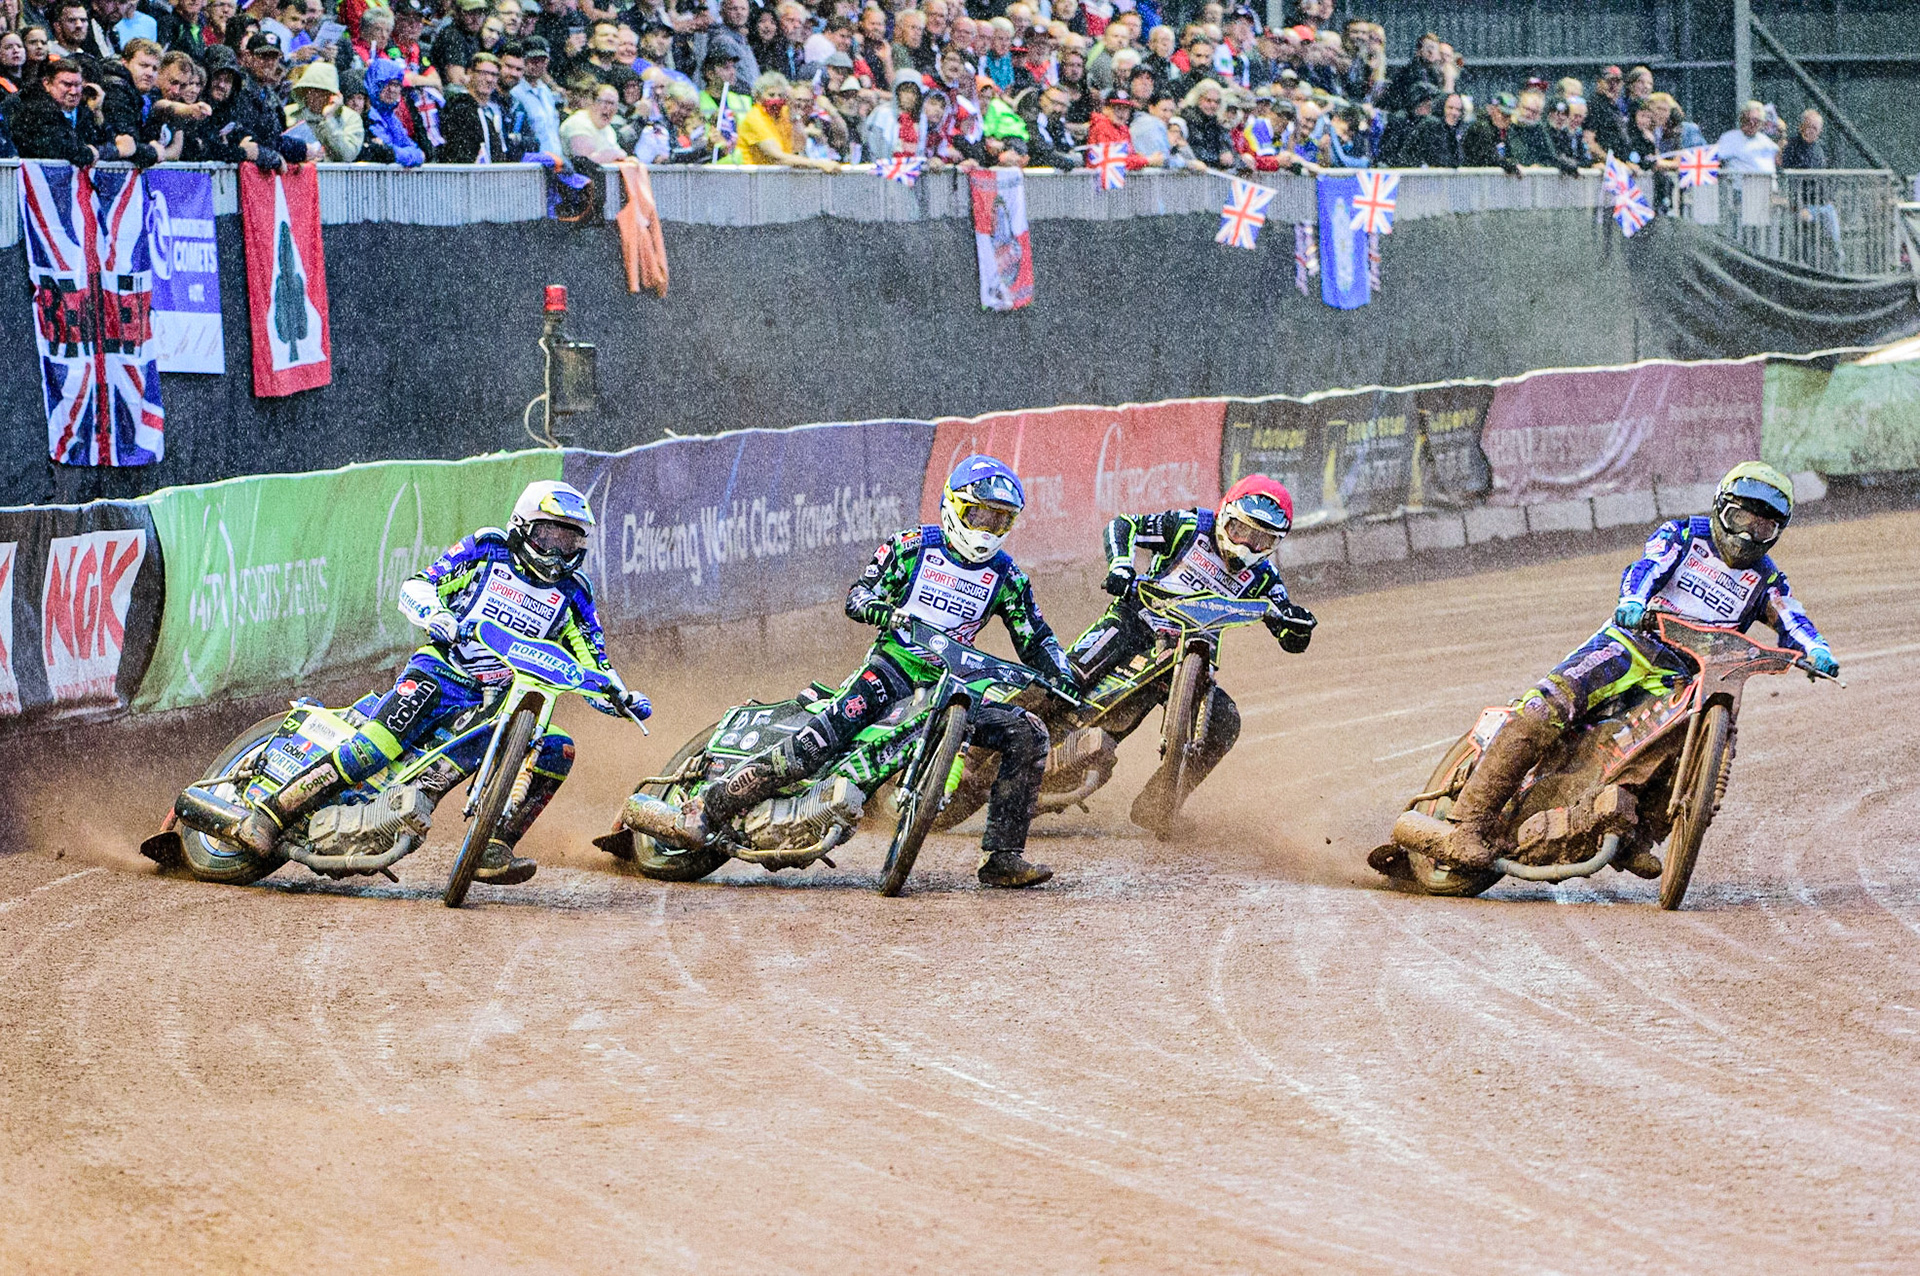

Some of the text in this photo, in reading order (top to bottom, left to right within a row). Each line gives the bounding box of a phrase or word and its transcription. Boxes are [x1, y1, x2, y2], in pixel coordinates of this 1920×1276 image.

[174, 241, 217, 273] COMETS
[621, 511, 700, 586] Delivering
[700, 501, 746, 563] World
[751, 497, 790, 557] Class
[794, 492, 838, 550] Travel
[923, 568, 988, 601] SPORTS INSURE
[981, 573, 994, 585] 9
[1190, 551, 1241, 595] SPORTS INSURE
[1687, 557, 1747, 600] SPORTS INSURE
[1740, 572, 1758, 586] 14
[45, 537, 139, 666] NGK
[490, 581, 555, 621] SPORTS INSURE
[547, 592, 561, 605] 3
[919, 590, 976, 620] 2022
[1677, 574, 1734, 619] 2022
[481, 602, 540, 638] 2022
[387, 680, 437, 732] tobin
[871, 679, 888, 703] FTS
[283, 718, 300, 731] 37
[268, 751, 300, 774] NORTHE
[282, 741, 306, 761] tobin
[300, 769, 335, 792] SPRINT
